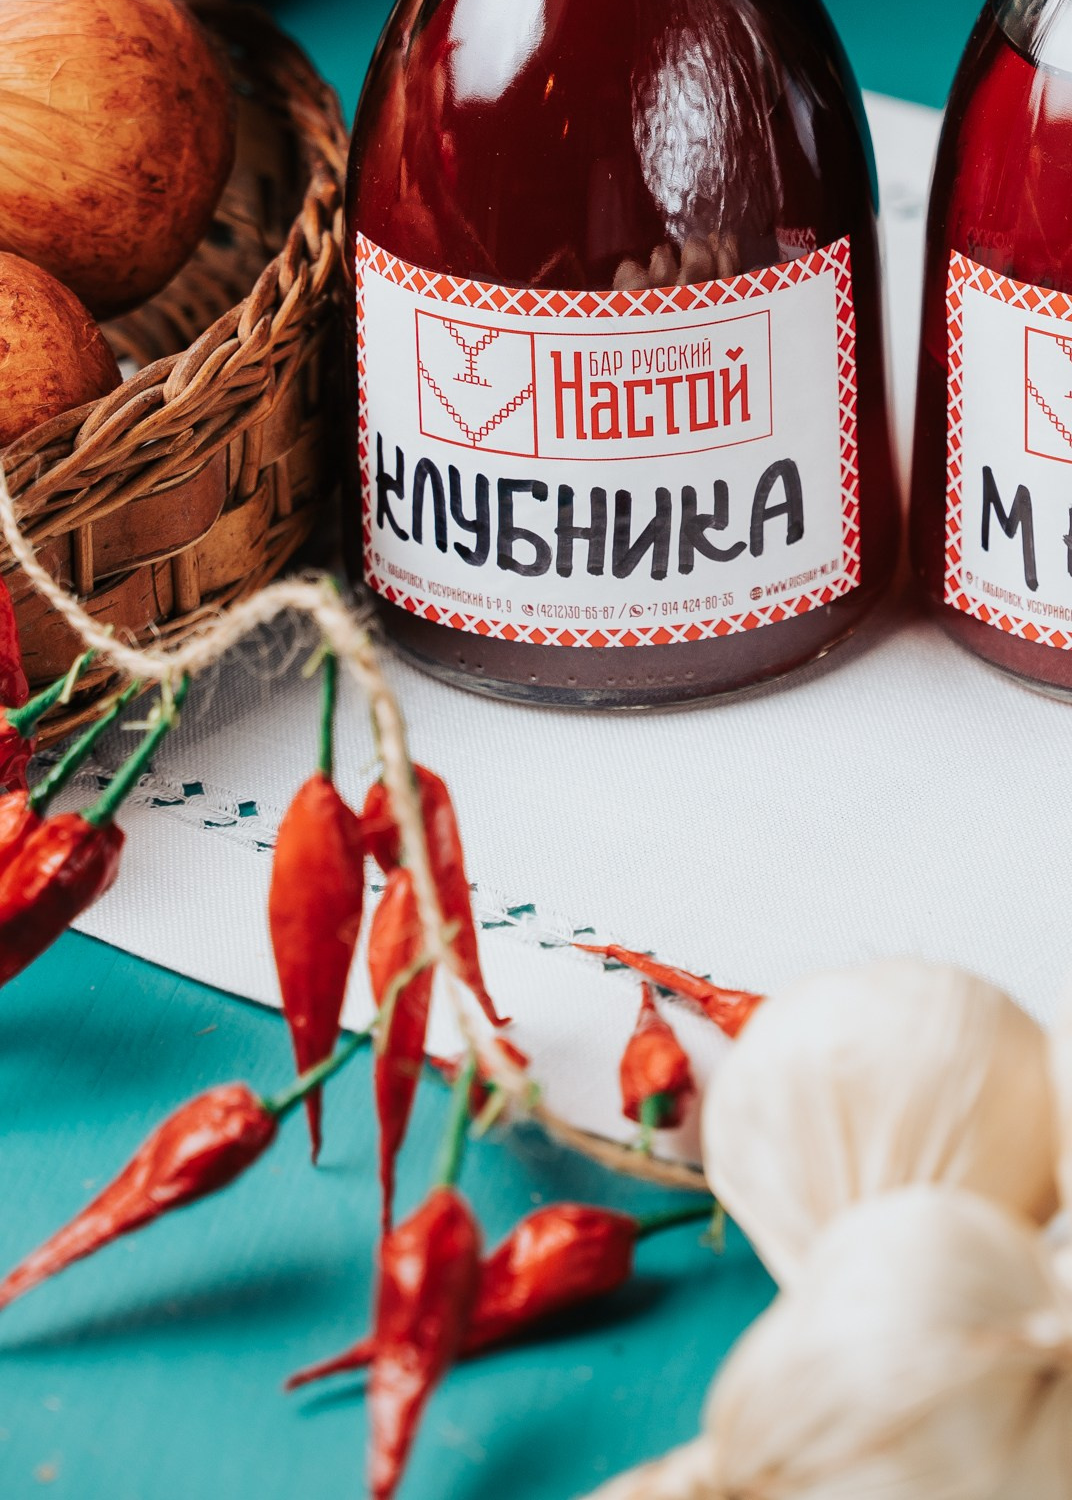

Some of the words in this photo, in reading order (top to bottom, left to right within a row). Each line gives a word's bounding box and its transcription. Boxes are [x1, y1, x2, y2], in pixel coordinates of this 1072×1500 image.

[589, 349, 623, 376] БАР
[632, 337, 712, 375] РУССКИЙ
[375, 431, 805, 581] КЛУБНИКА
[428, 580, 484, 607] УССУРИЙСКИЙ
[506, 600, 512, 613] 9
[537, 603, 614, 619] (4212)30-65-87
[647, 604, 657, 616] +7
[662, 601, 678, 615] 914
[683, 592, 734, 613] 424-80-35
